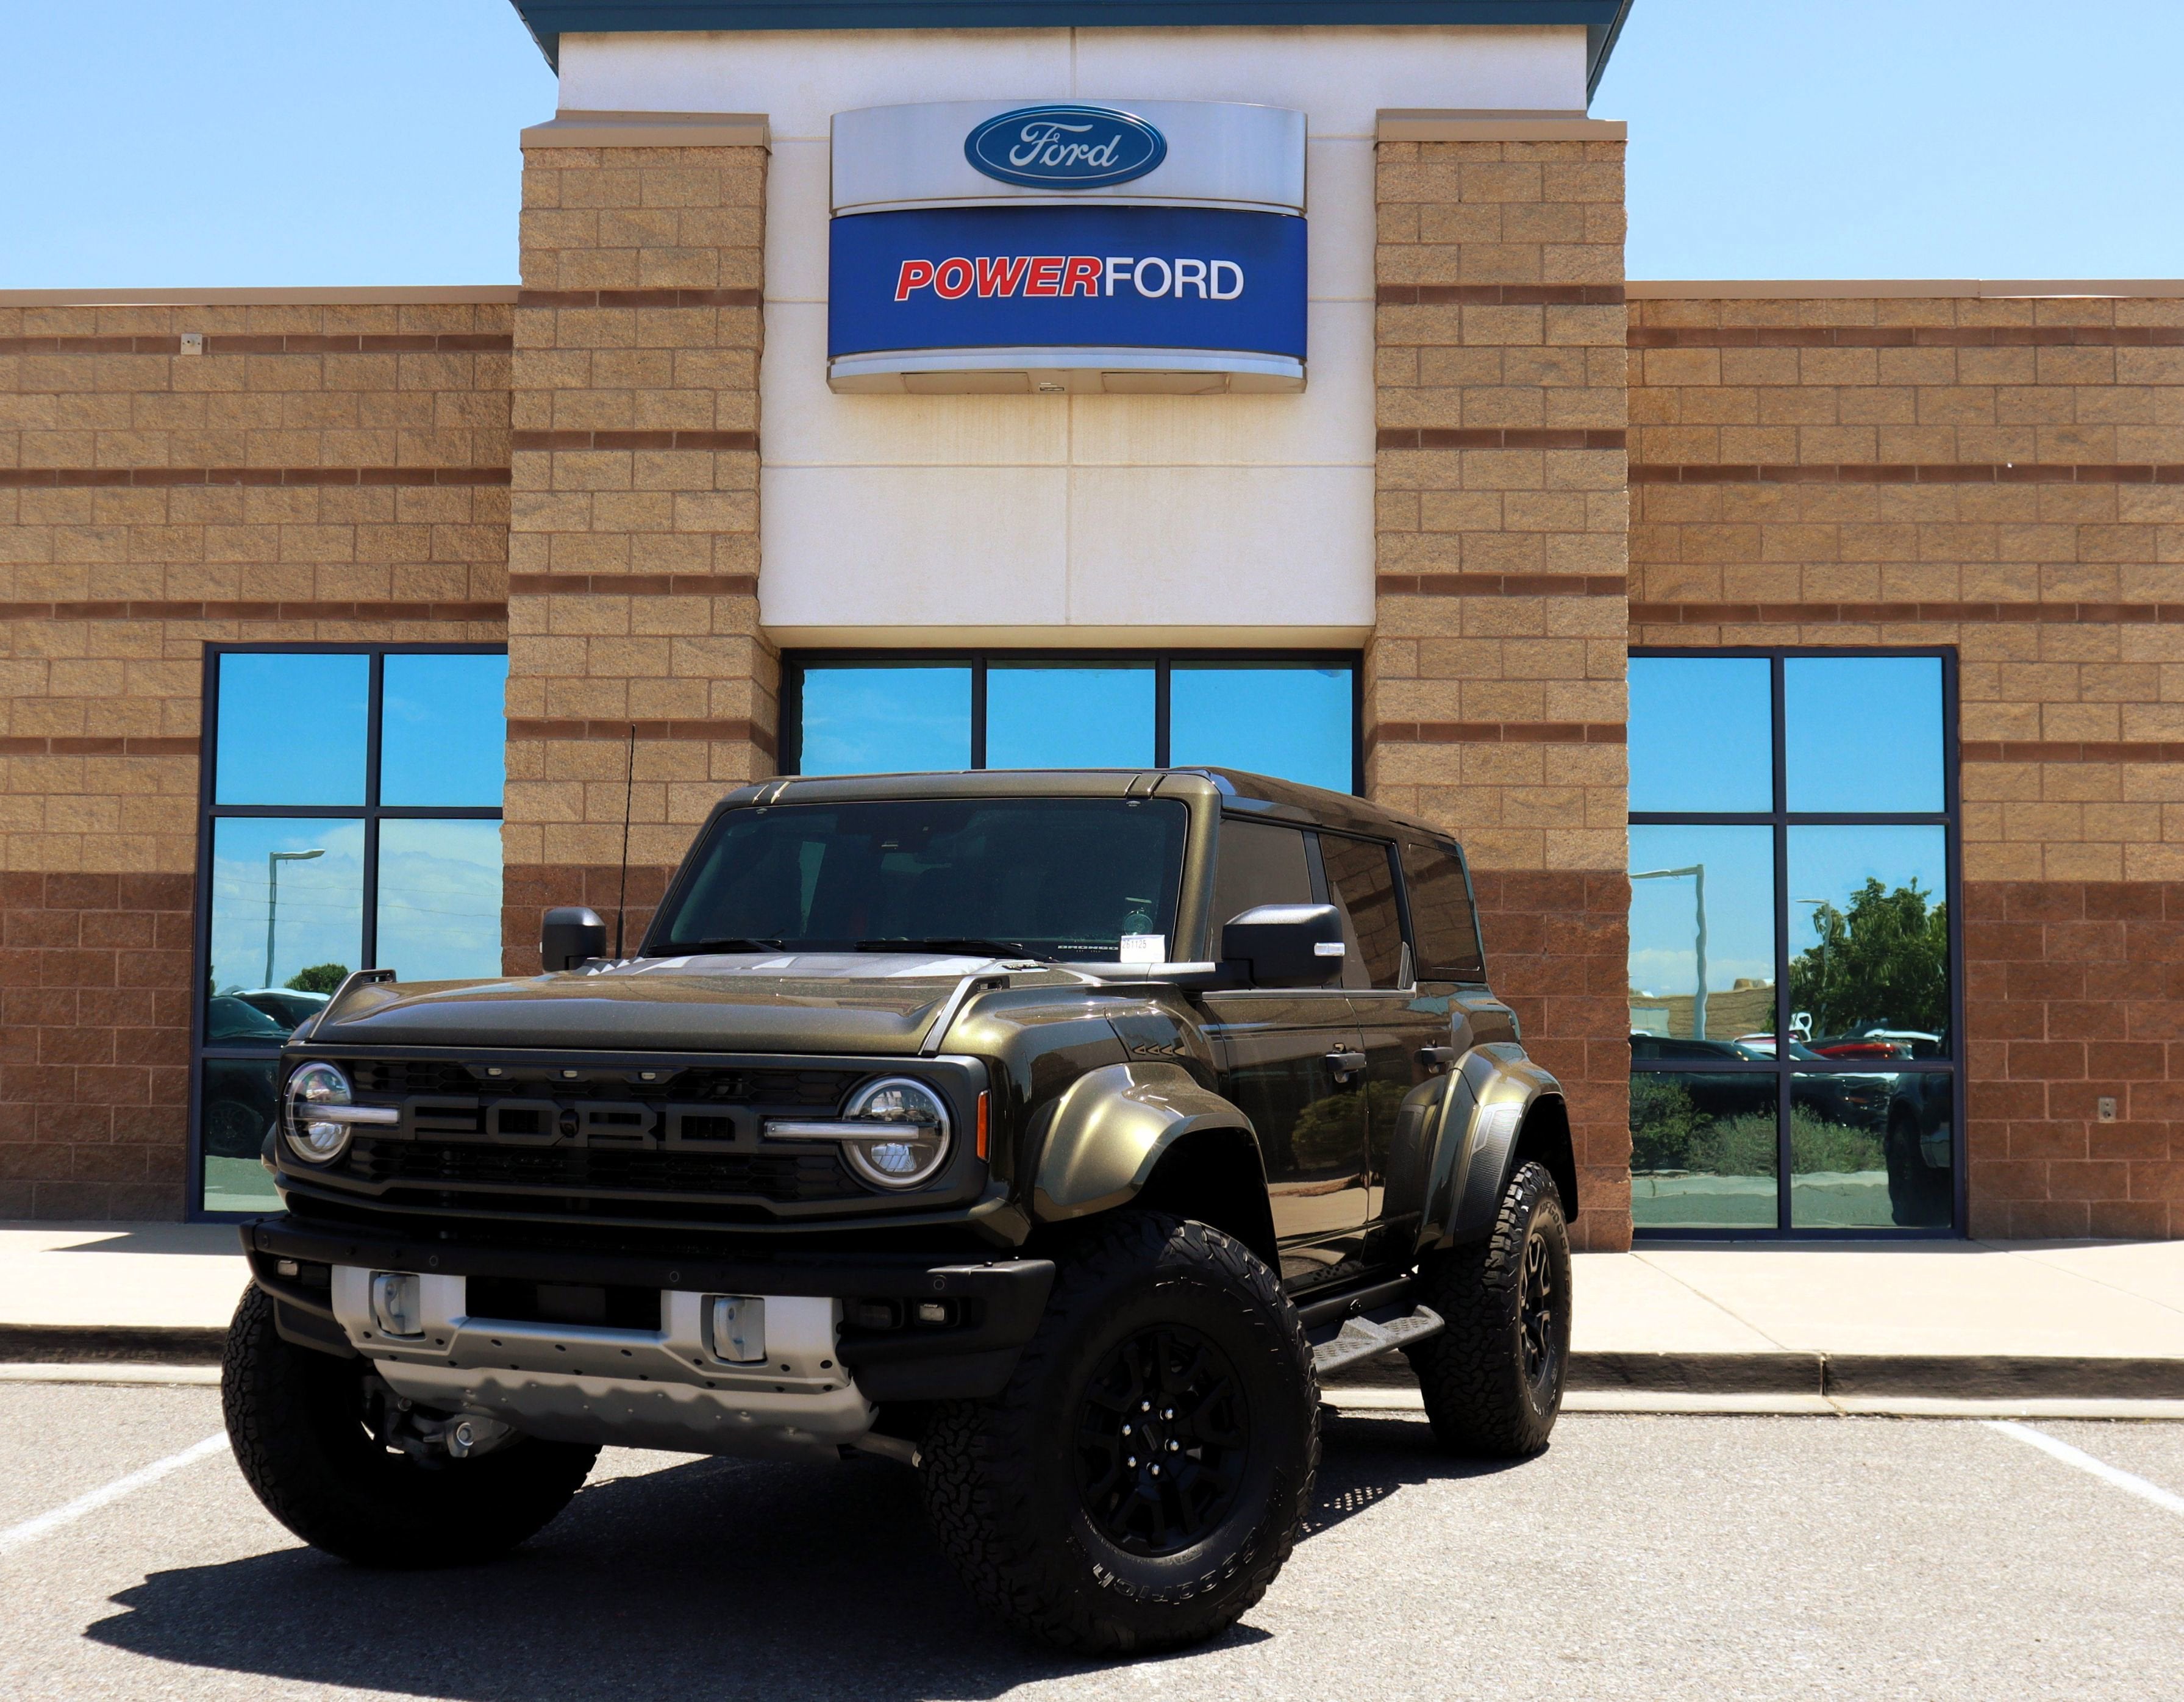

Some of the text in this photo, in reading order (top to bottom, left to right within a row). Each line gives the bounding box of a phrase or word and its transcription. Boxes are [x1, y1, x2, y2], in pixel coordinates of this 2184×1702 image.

[1009, 122, 1122, 168] Ford
[894, 256, 1244, 301] POWERFORD
[402, 1096, 755, 1153] FORD
